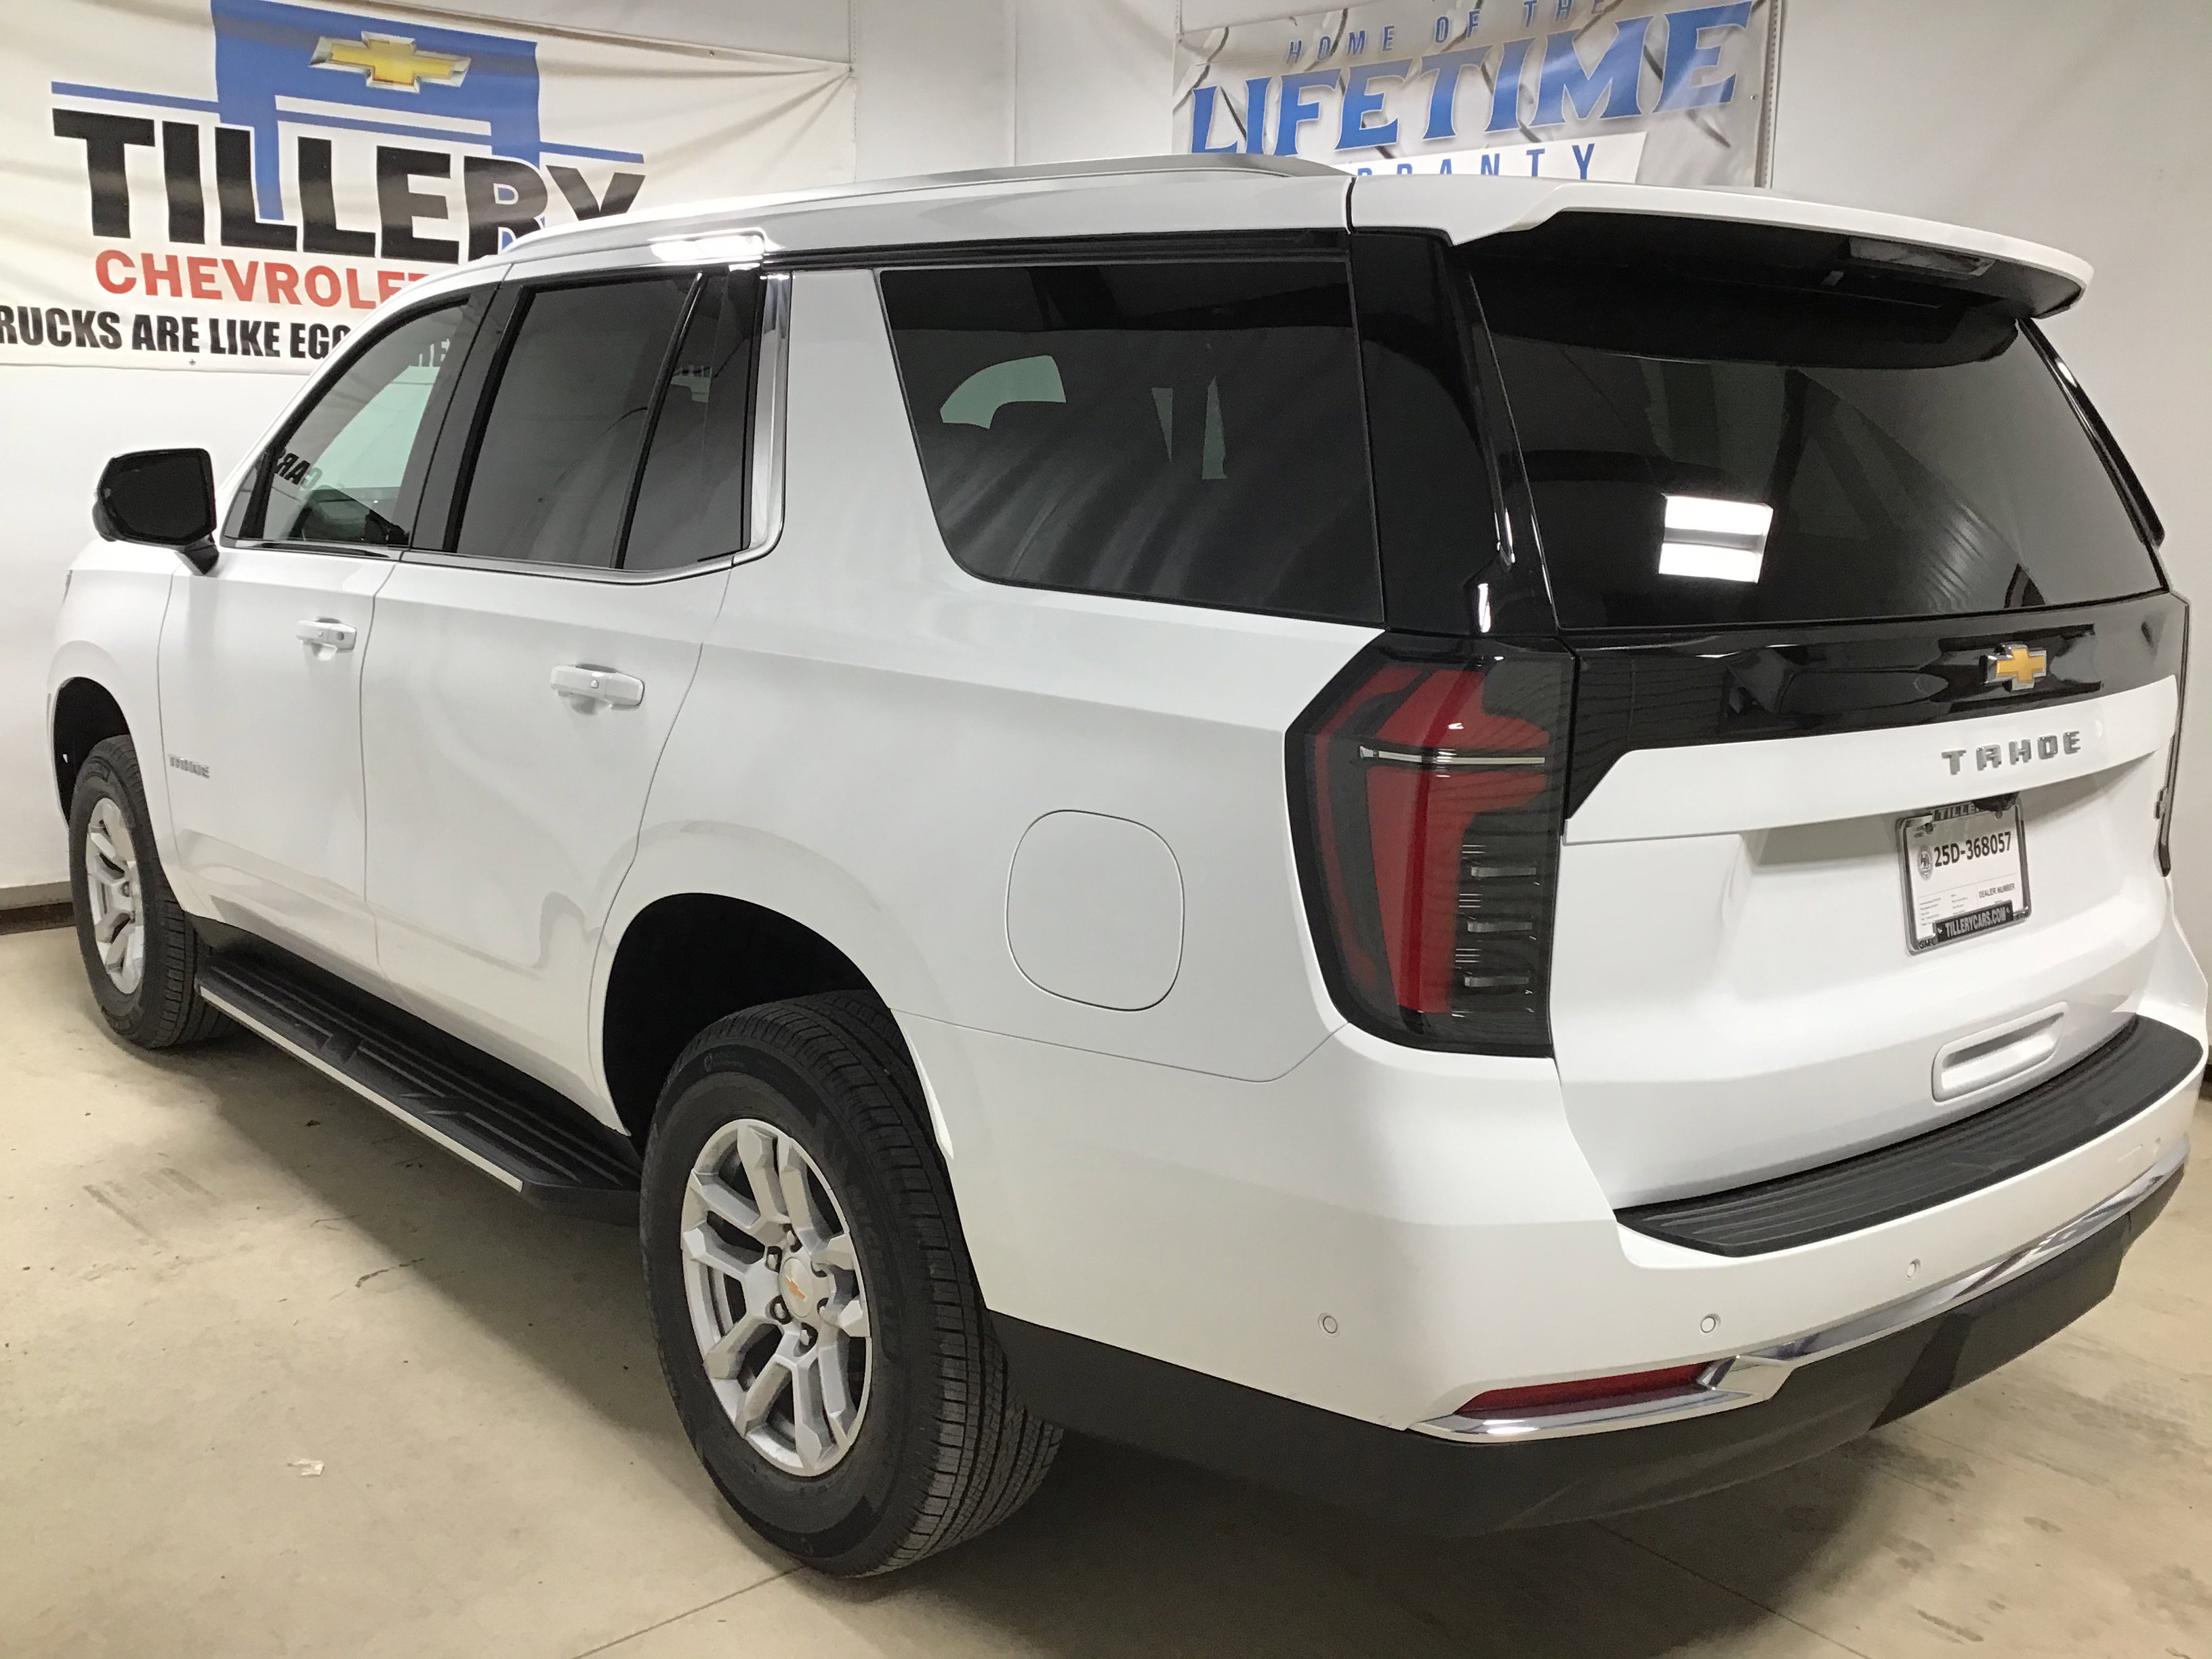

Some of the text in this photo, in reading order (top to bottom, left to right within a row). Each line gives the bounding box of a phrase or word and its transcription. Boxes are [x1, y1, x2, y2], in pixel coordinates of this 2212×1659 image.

[1287, 25, 1395, 64] HOME
[1435, 10, 1480, 43] OF
[1191, 1, 1754, 157] LIFETIME
[52, 108, 647, 264] TILLERY
[95, 249, 431, 310] CHEVROLE
[131, 314, 200, 354] ARE
[209, 318, 281, 358] LIKE
[1941, 731, 2081, 775] TAHOE
[1933, 831, 2011, 867] 25D-368057
[1978, 887, 1996, 899] DEALER
[1944, 905, 2007, 937] TILLERYCARS.COM
